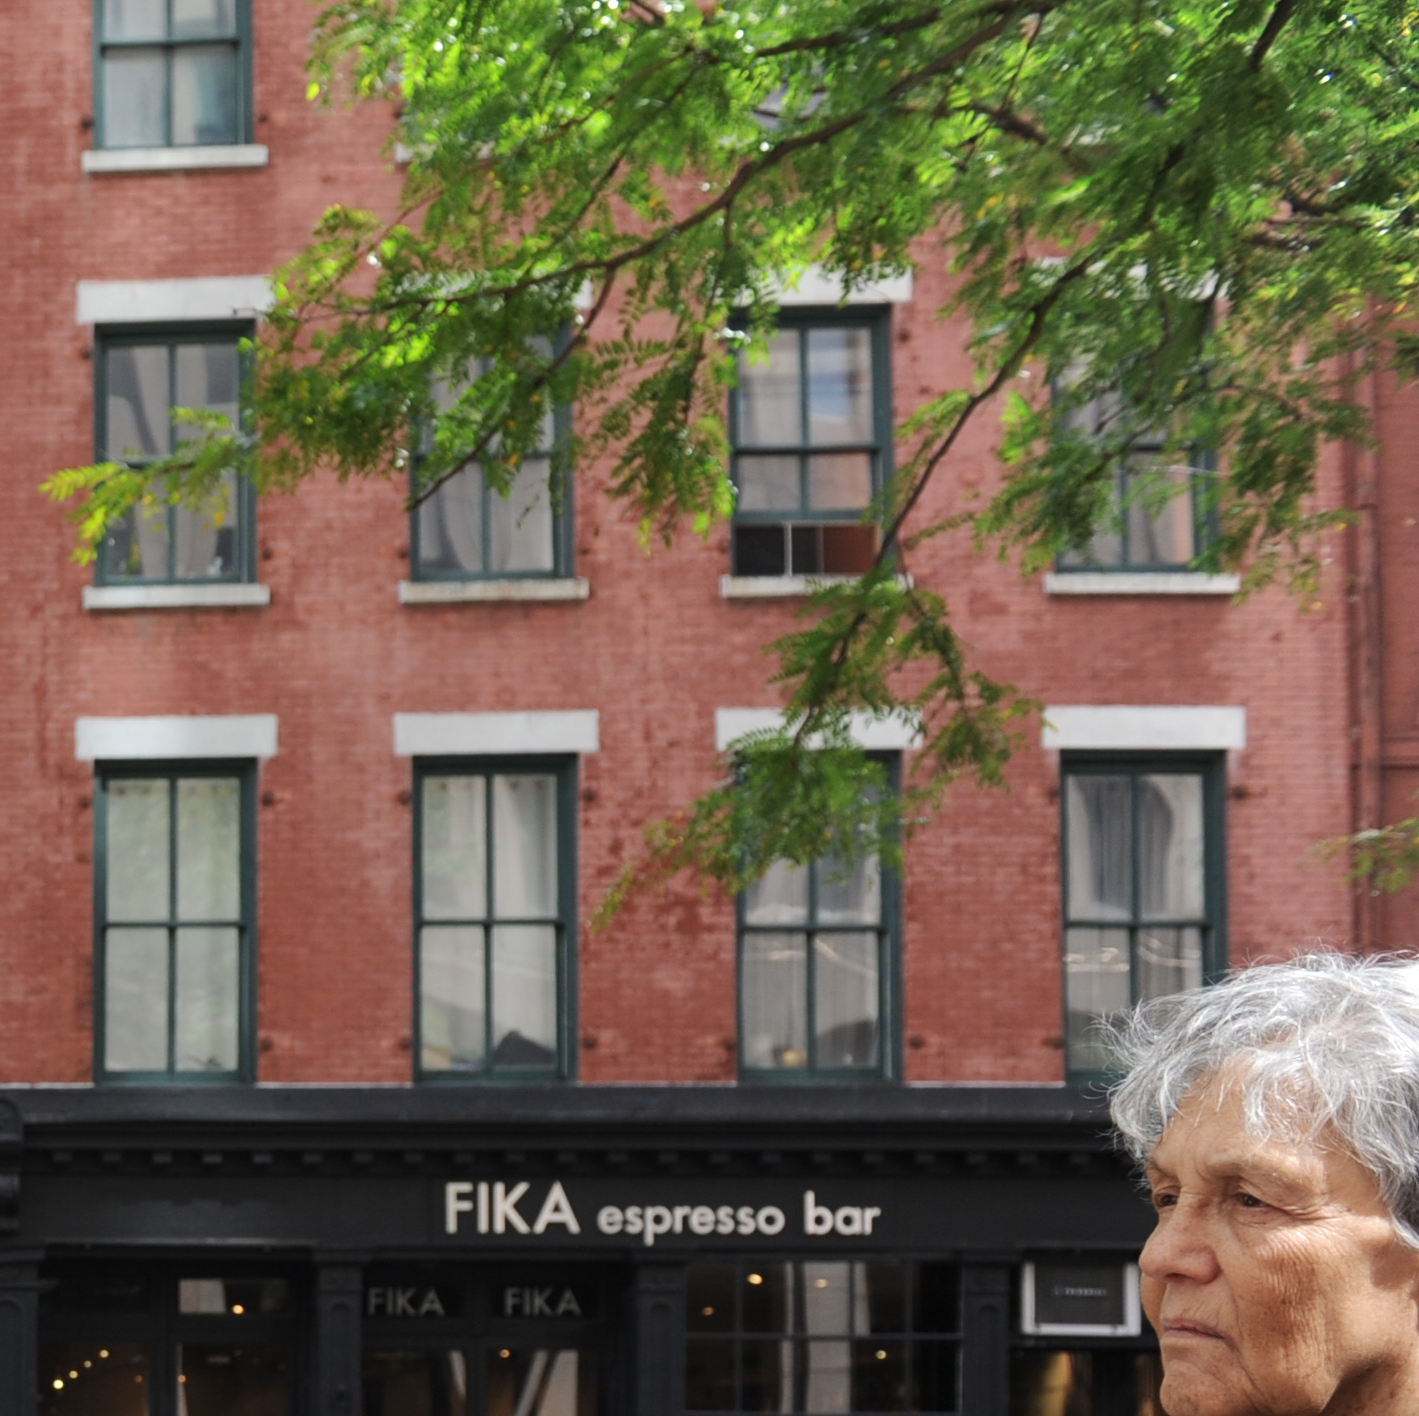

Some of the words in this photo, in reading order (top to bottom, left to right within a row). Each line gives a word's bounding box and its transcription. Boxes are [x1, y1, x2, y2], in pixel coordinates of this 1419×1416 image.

[445, 1181, 581, 1234] FIKA
[597, 1206, 786, 1247] espresso
[804, 1190, 881, 1236] bar
[368, 1287, 445, 1317] FIKA
[504, 1287, 582, 1317] FIKA
